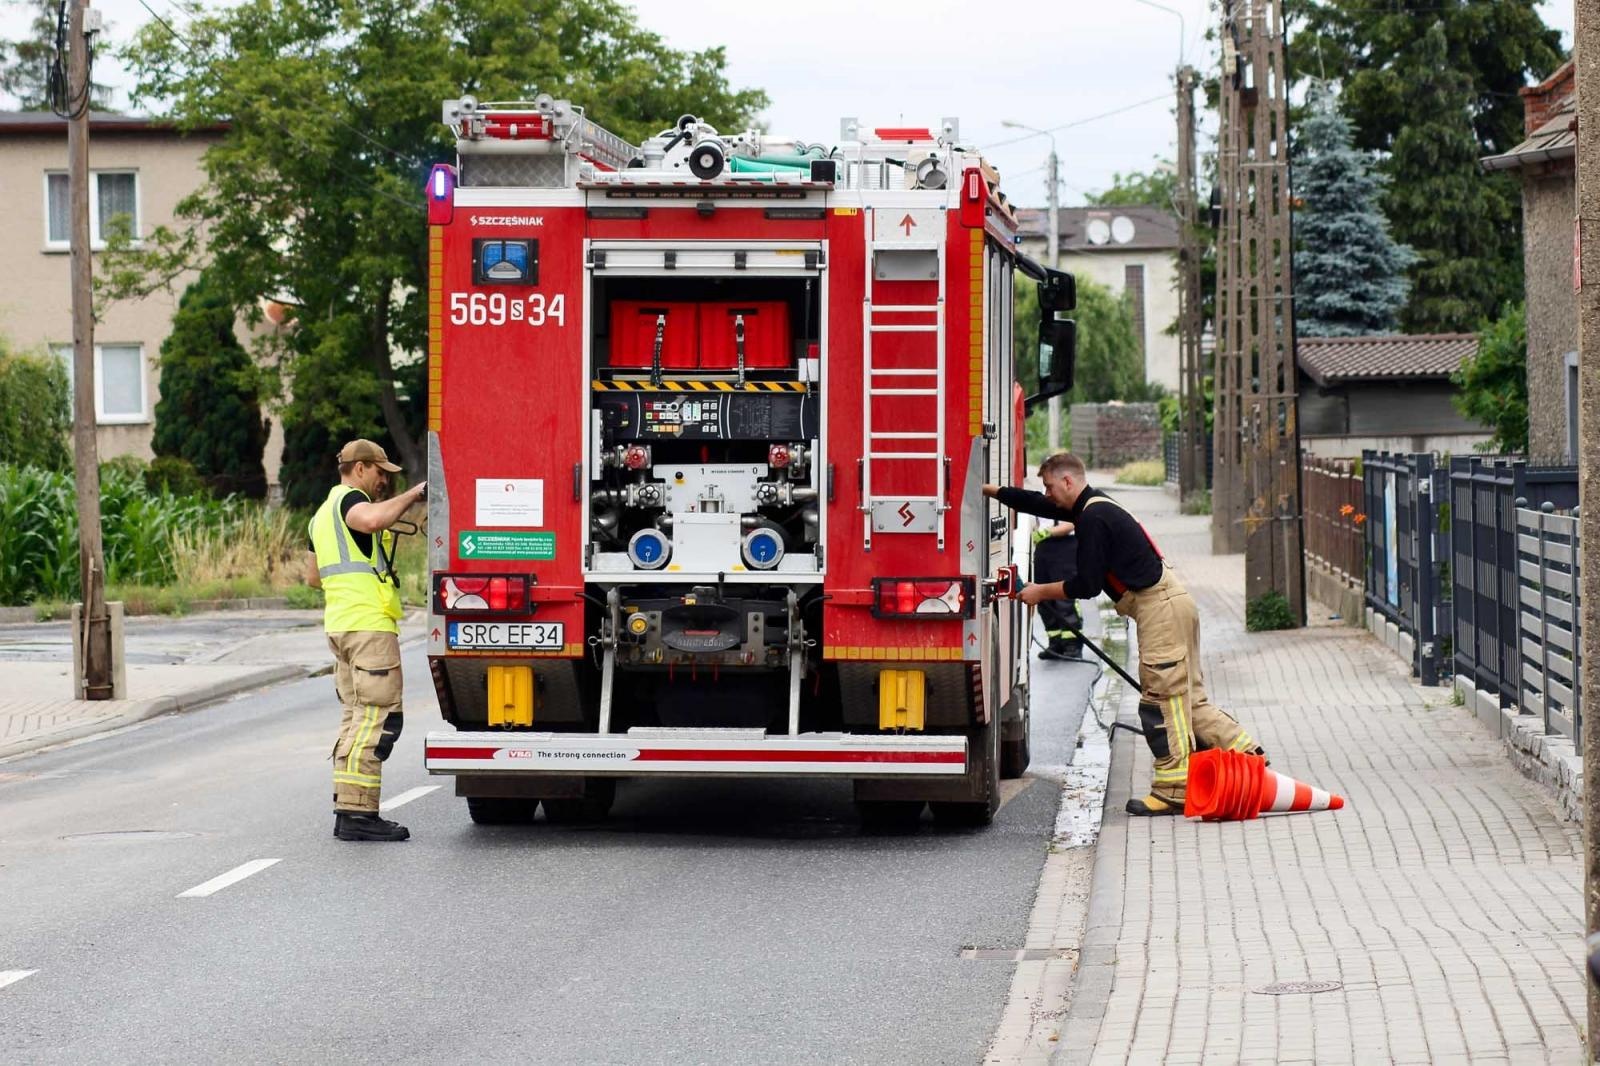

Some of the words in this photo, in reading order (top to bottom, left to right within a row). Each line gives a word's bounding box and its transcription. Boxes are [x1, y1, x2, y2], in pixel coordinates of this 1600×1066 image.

[478, 216, 544, 227] SZCZĘŚNIAK
[450, 292, 507, 326] 569
[512, 302, 522, 318] S
[528, 293, 565, 327] 34
[462, 625, 500, 644] SRC
[508, 625, 558, 644] EF34
[538, 751, 552, 759] The
[554, 751, 580, 760] strong
[582, 751, 626, 759] connection
